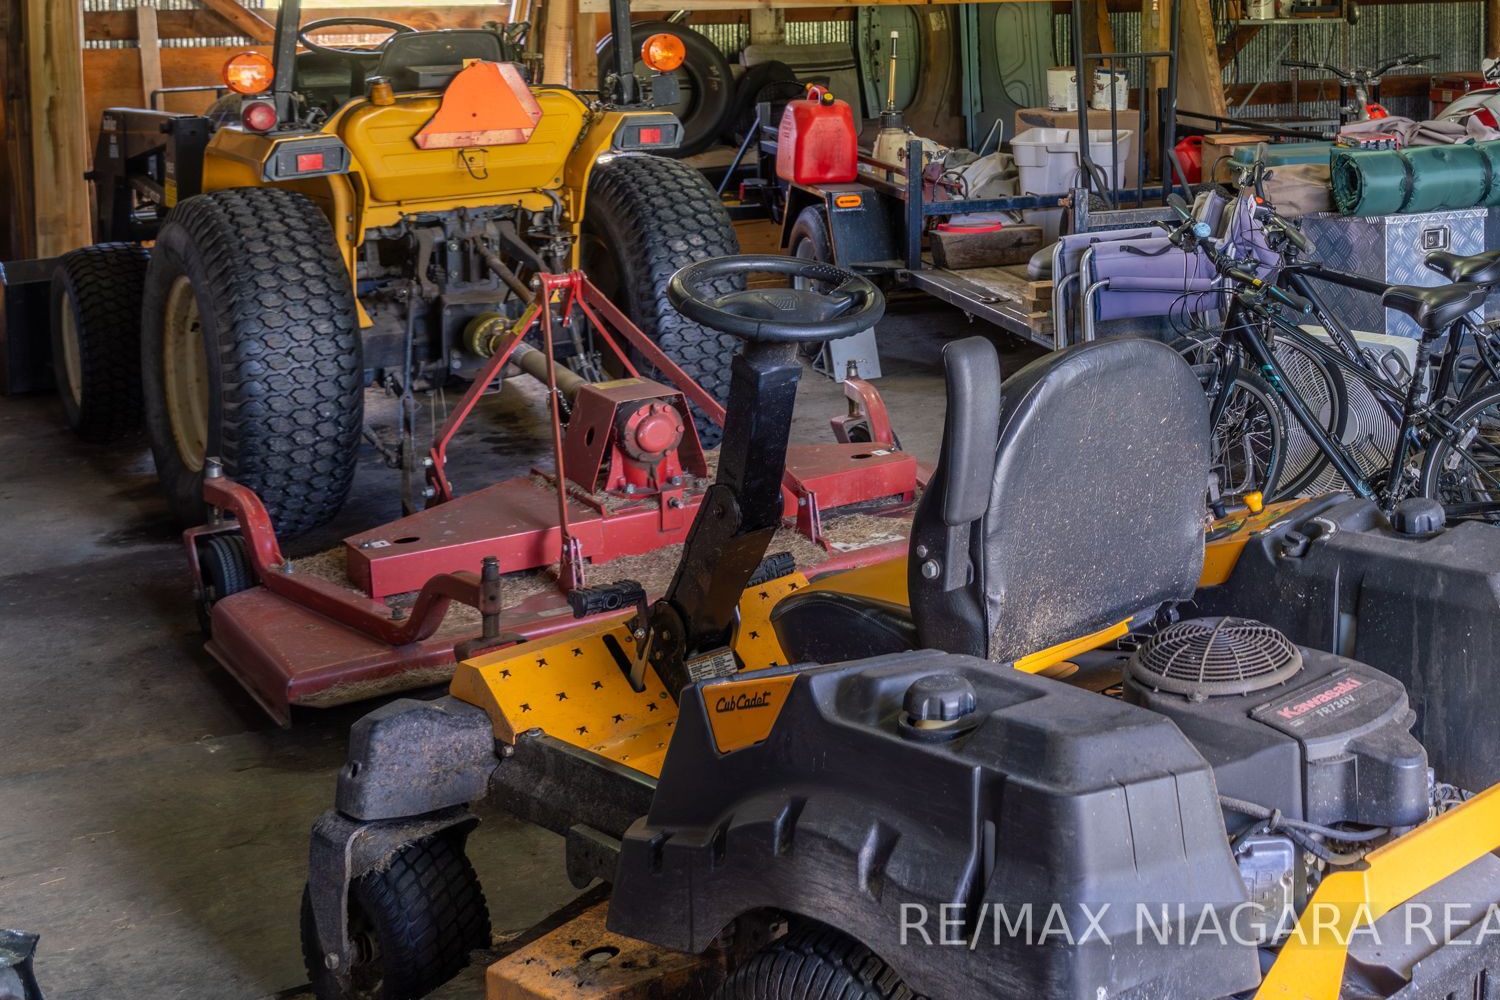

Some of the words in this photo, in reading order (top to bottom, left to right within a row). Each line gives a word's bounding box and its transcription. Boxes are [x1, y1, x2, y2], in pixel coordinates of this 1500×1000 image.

[716, 695, 736, 713] Cub
[736, 690, 772, 711] Cadet
[1276, 677, 1363, 719] Kawasaki
